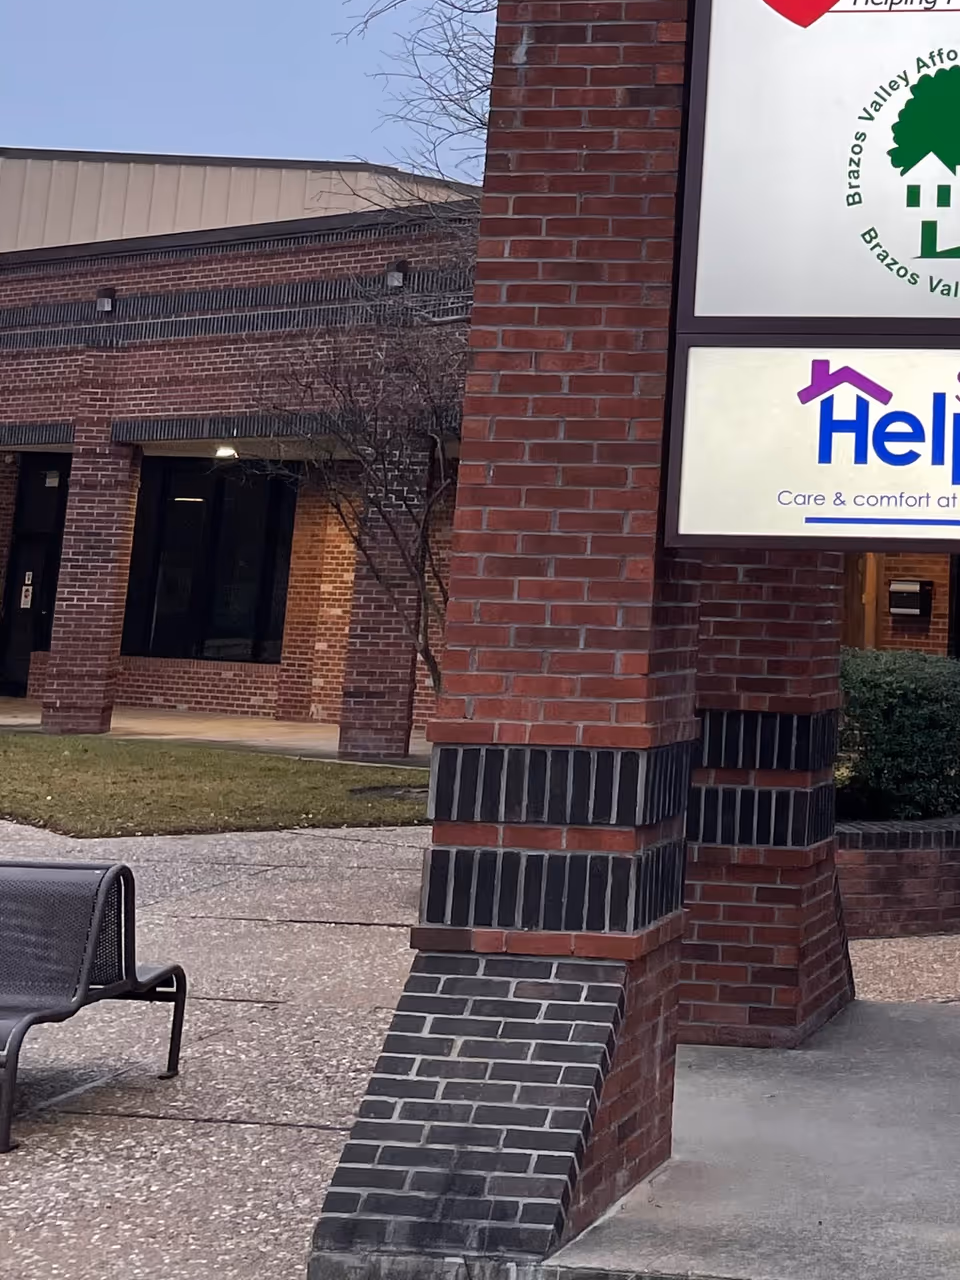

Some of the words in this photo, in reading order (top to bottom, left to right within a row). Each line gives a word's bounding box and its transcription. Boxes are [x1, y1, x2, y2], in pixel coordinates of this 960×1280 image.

[846, 131, 866, 206] Brazos
[858, 70, 909, 121] Valley
[861, 227, 919, 285] Brazos
[778, 490, 825, 506] Care
[833, 491, 846, 507] &
[853, 491, 930, 508] comfort
[937, 492, 957, 508] at
